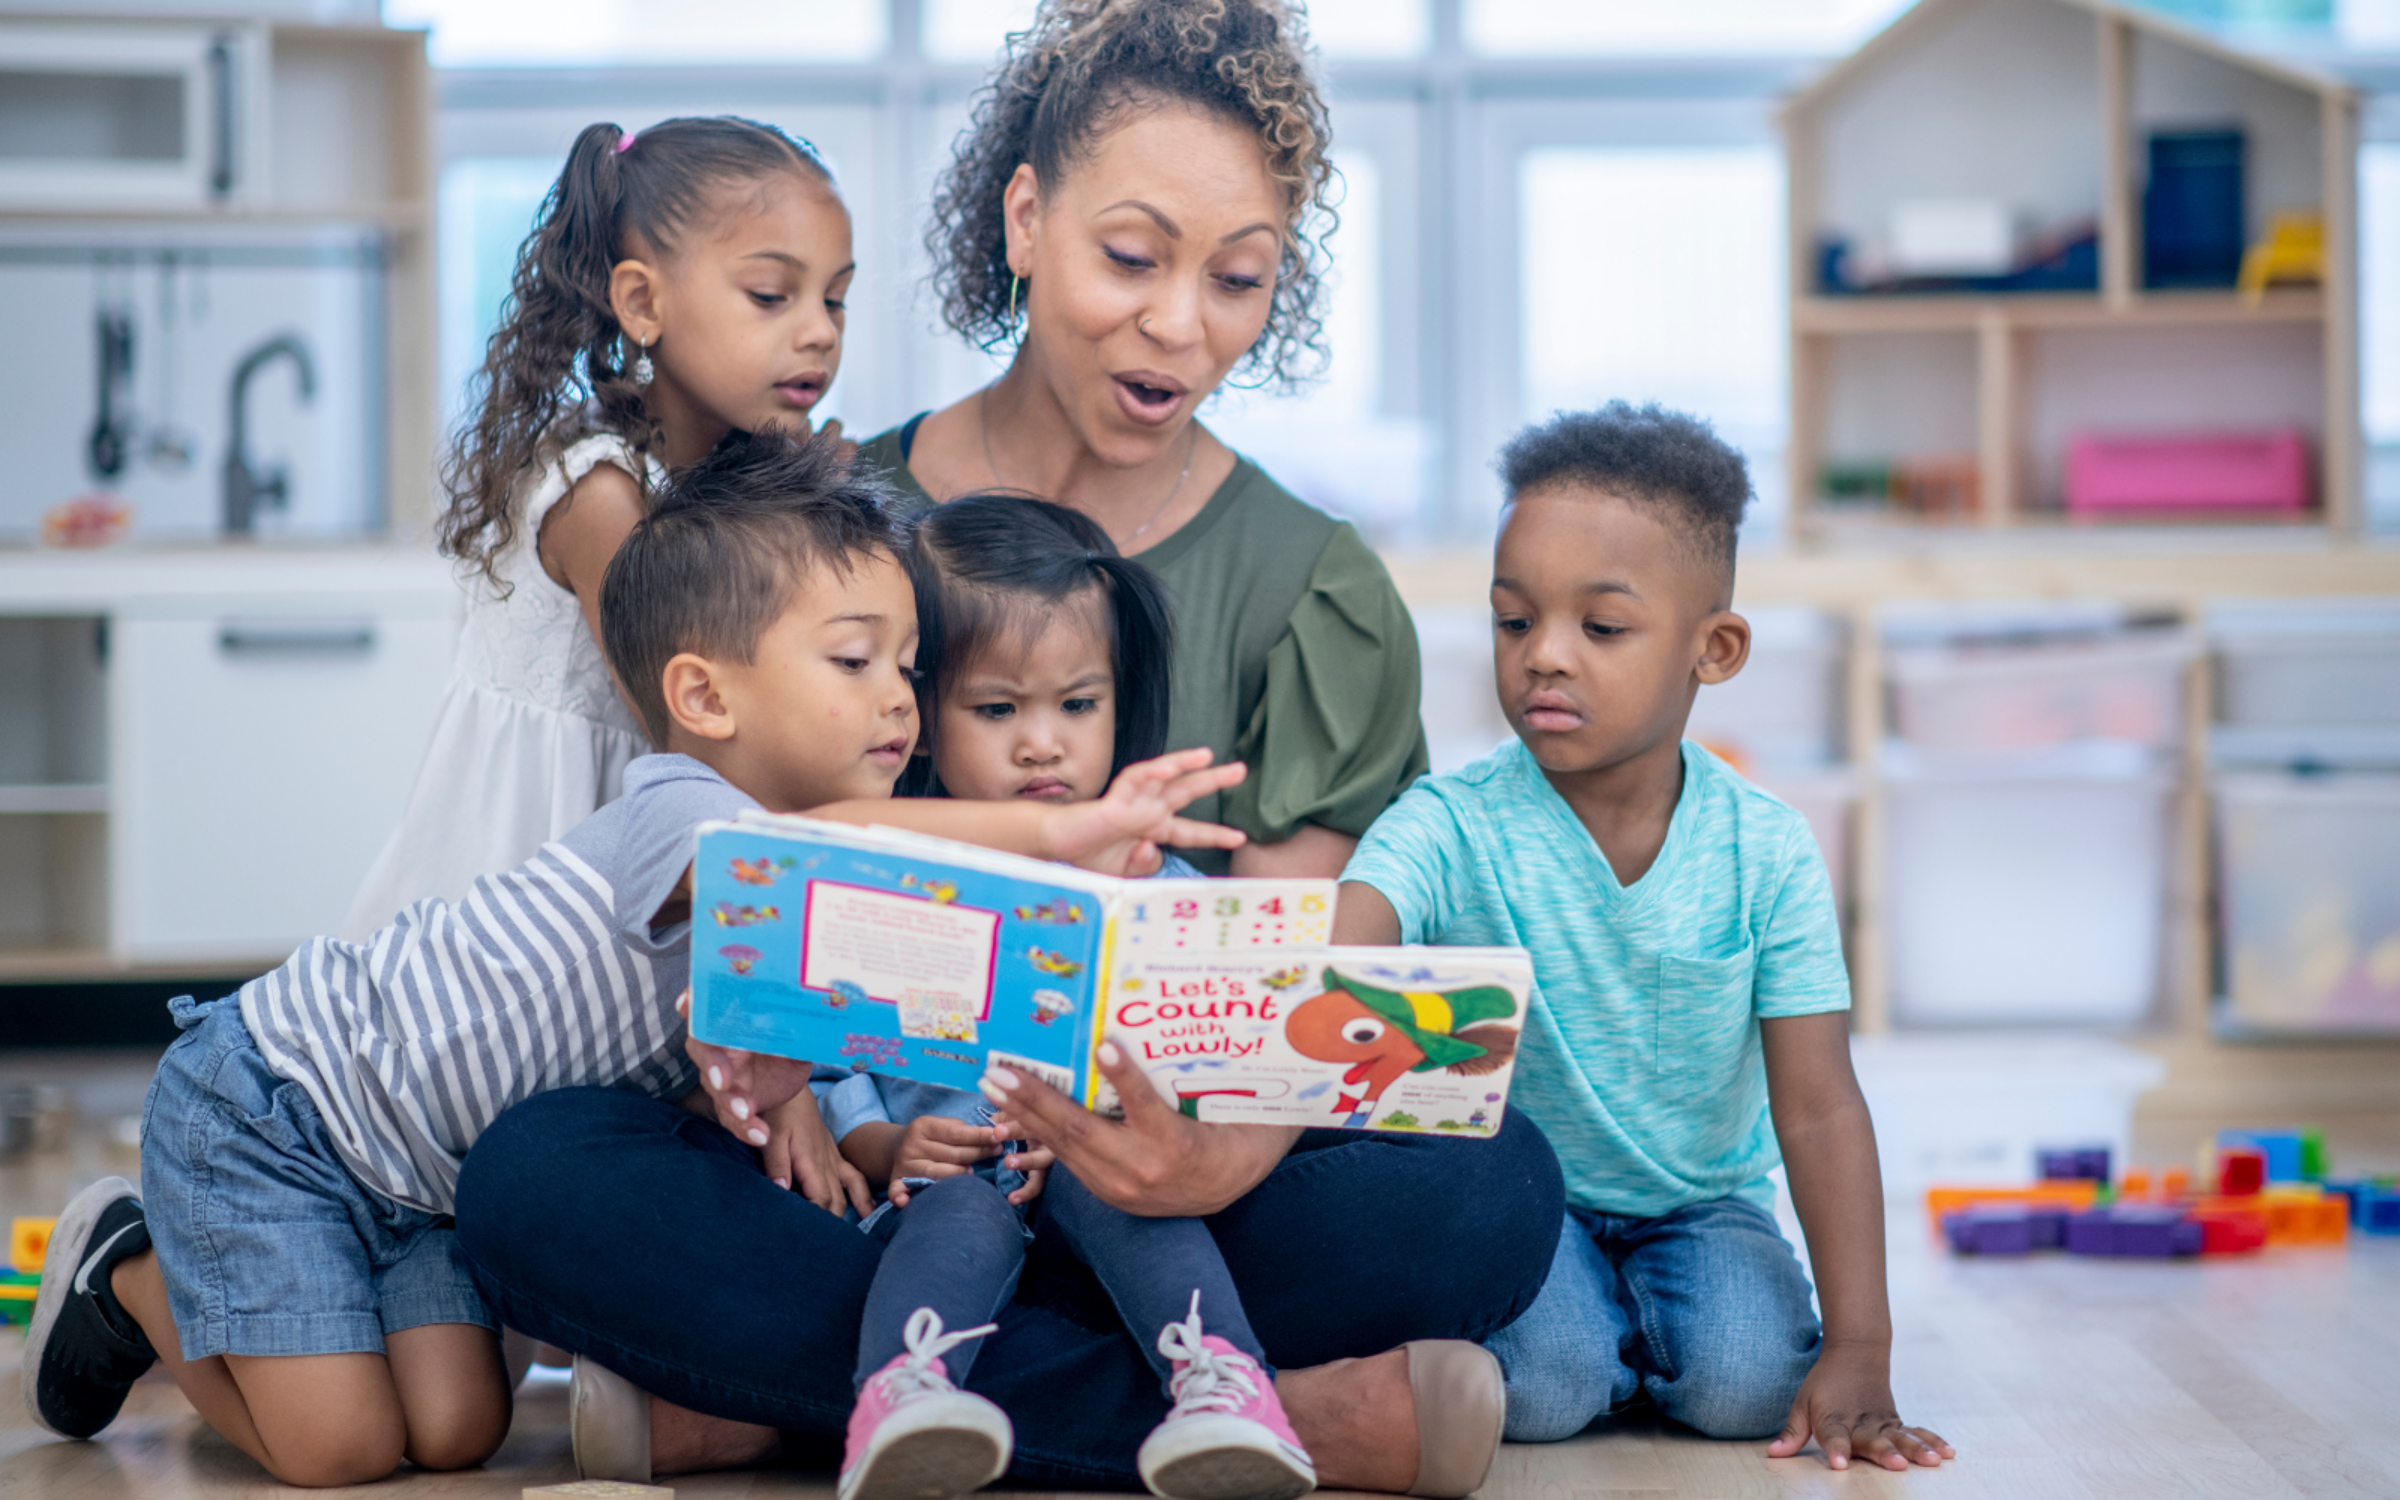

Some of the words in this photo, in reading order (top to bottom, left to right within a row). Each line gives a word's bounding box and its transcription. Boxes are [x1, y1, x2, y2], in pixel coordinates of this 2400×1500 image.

[1130, 902, 1149, 923] 1
[1172, 898, 1199, 920] 2
[1214, 895, 1241, 918] 3
[1257, 895, 1285, 917] 4
[1299, 892, 1327, 914] 5
[1159, 975, 1247, 998] Let's
[1116, 995, 1279, 1028] Count
[1159, 1022, 1225, 1039] with
[1142, 1035, 1264, 1060] Lowly!
